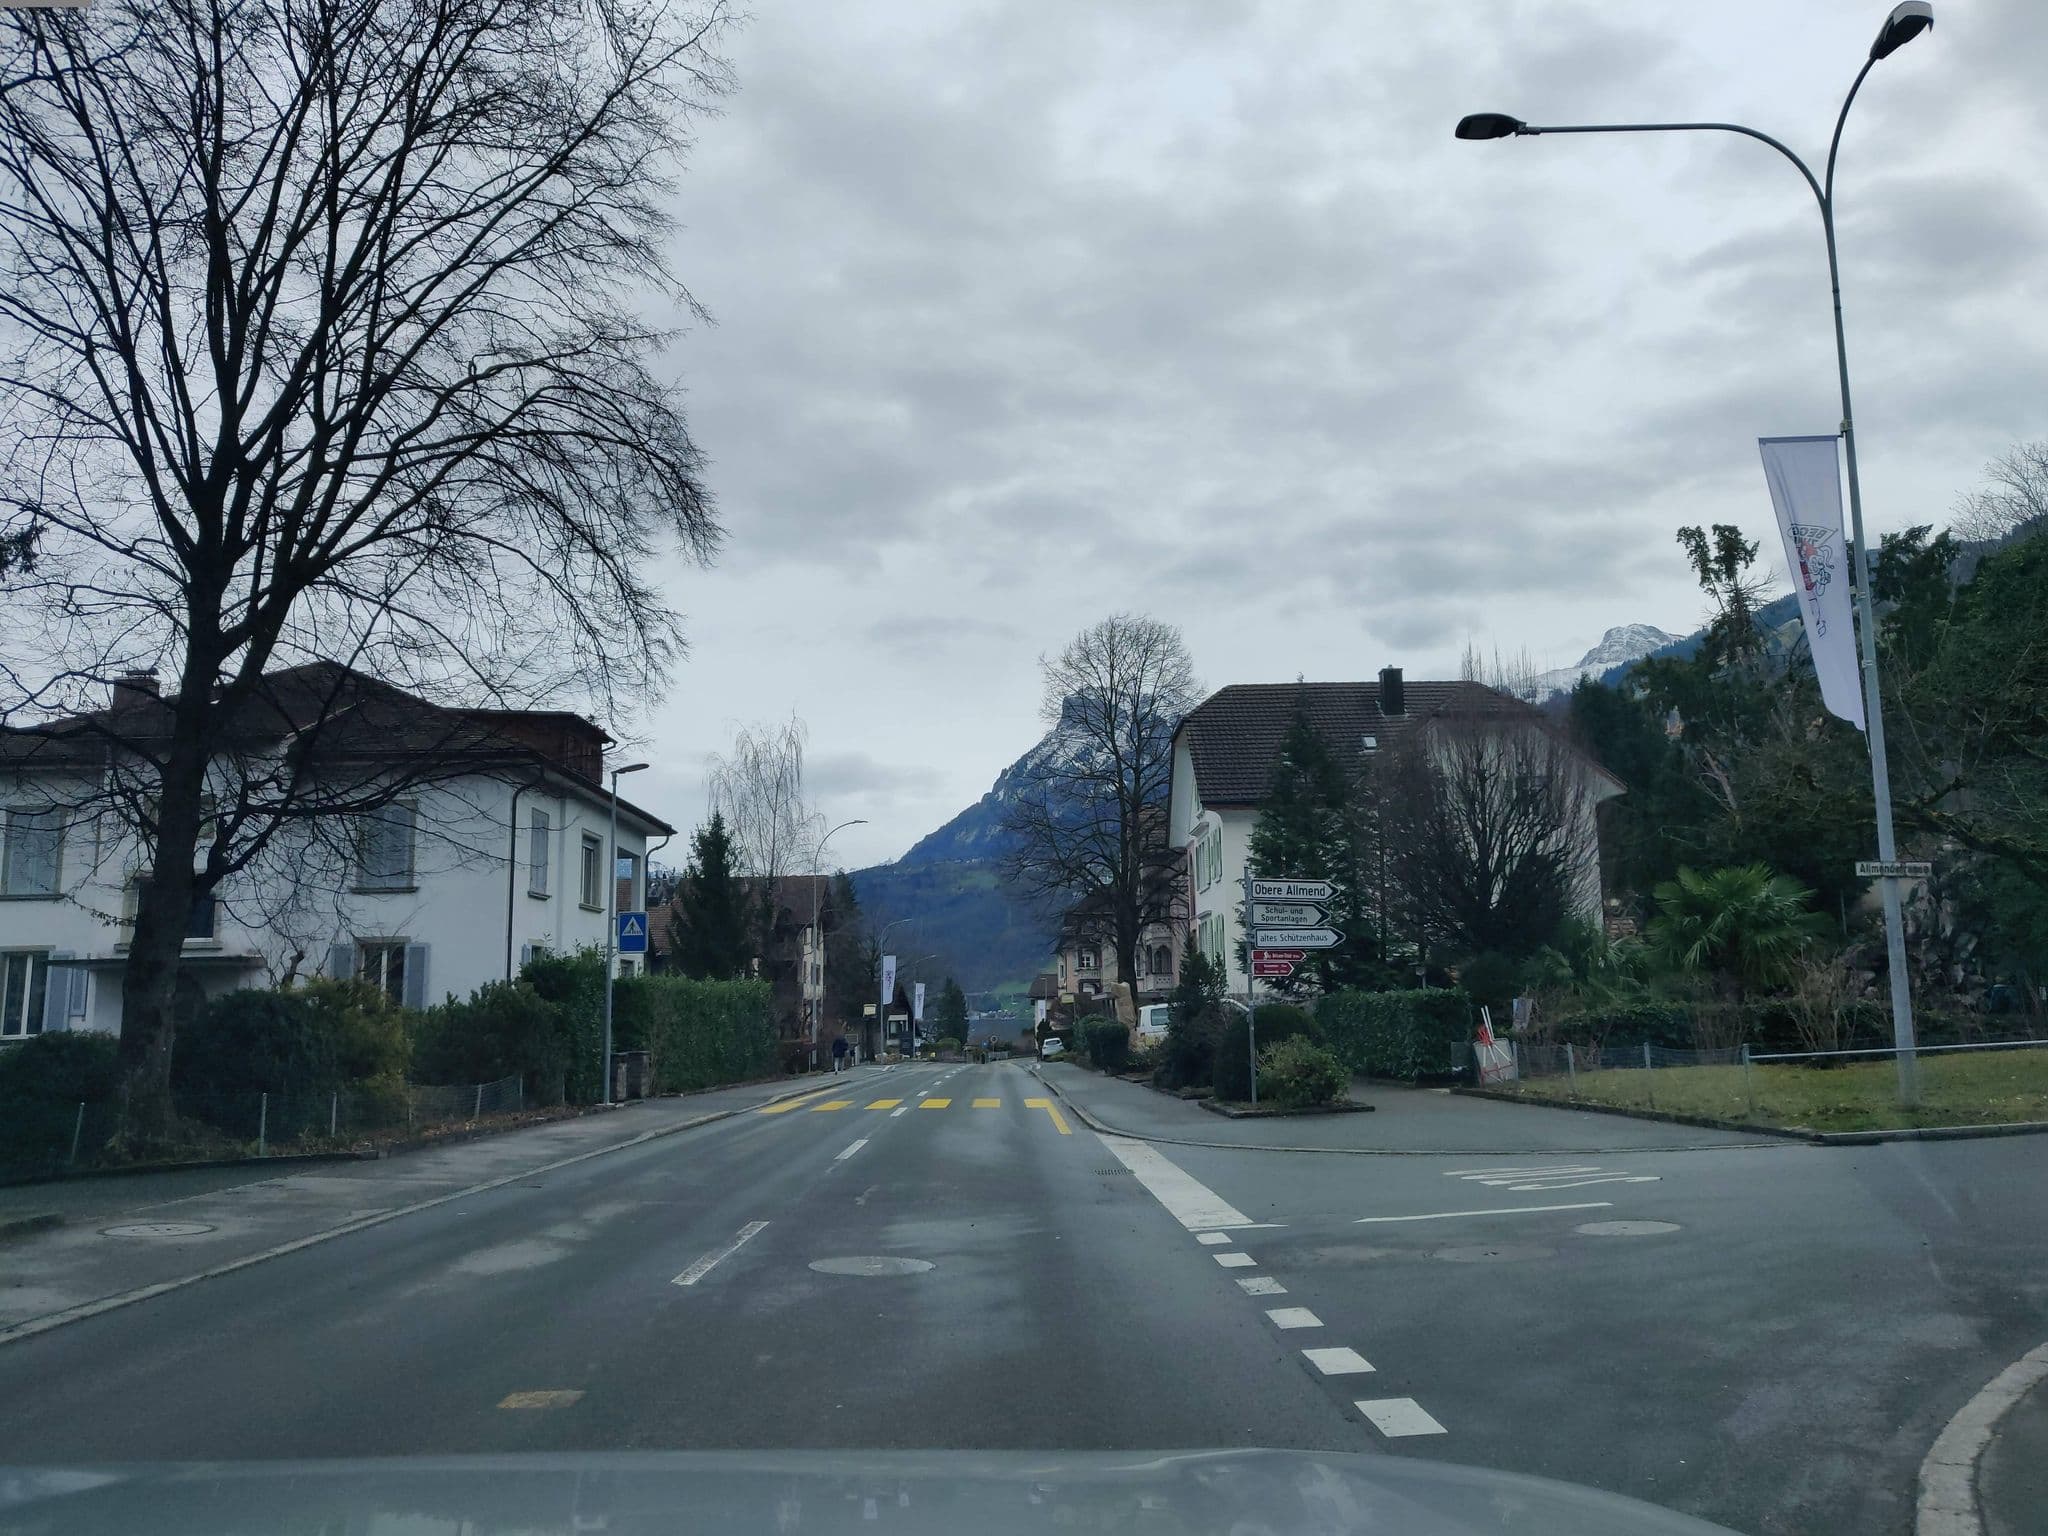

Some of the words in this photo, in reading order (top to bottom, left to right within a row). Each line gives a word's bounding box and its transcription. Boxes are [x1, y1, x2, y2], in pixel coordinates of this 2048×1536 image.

[1254, 883, 1283, 895] Obere
[1286, 884, 1326, 897] Allmend
[1265, 906, 1288, 914] Schul-
[1261, 914, 1308, 924] Sportanlagen
[1260, 934, 1278, 942] altes
